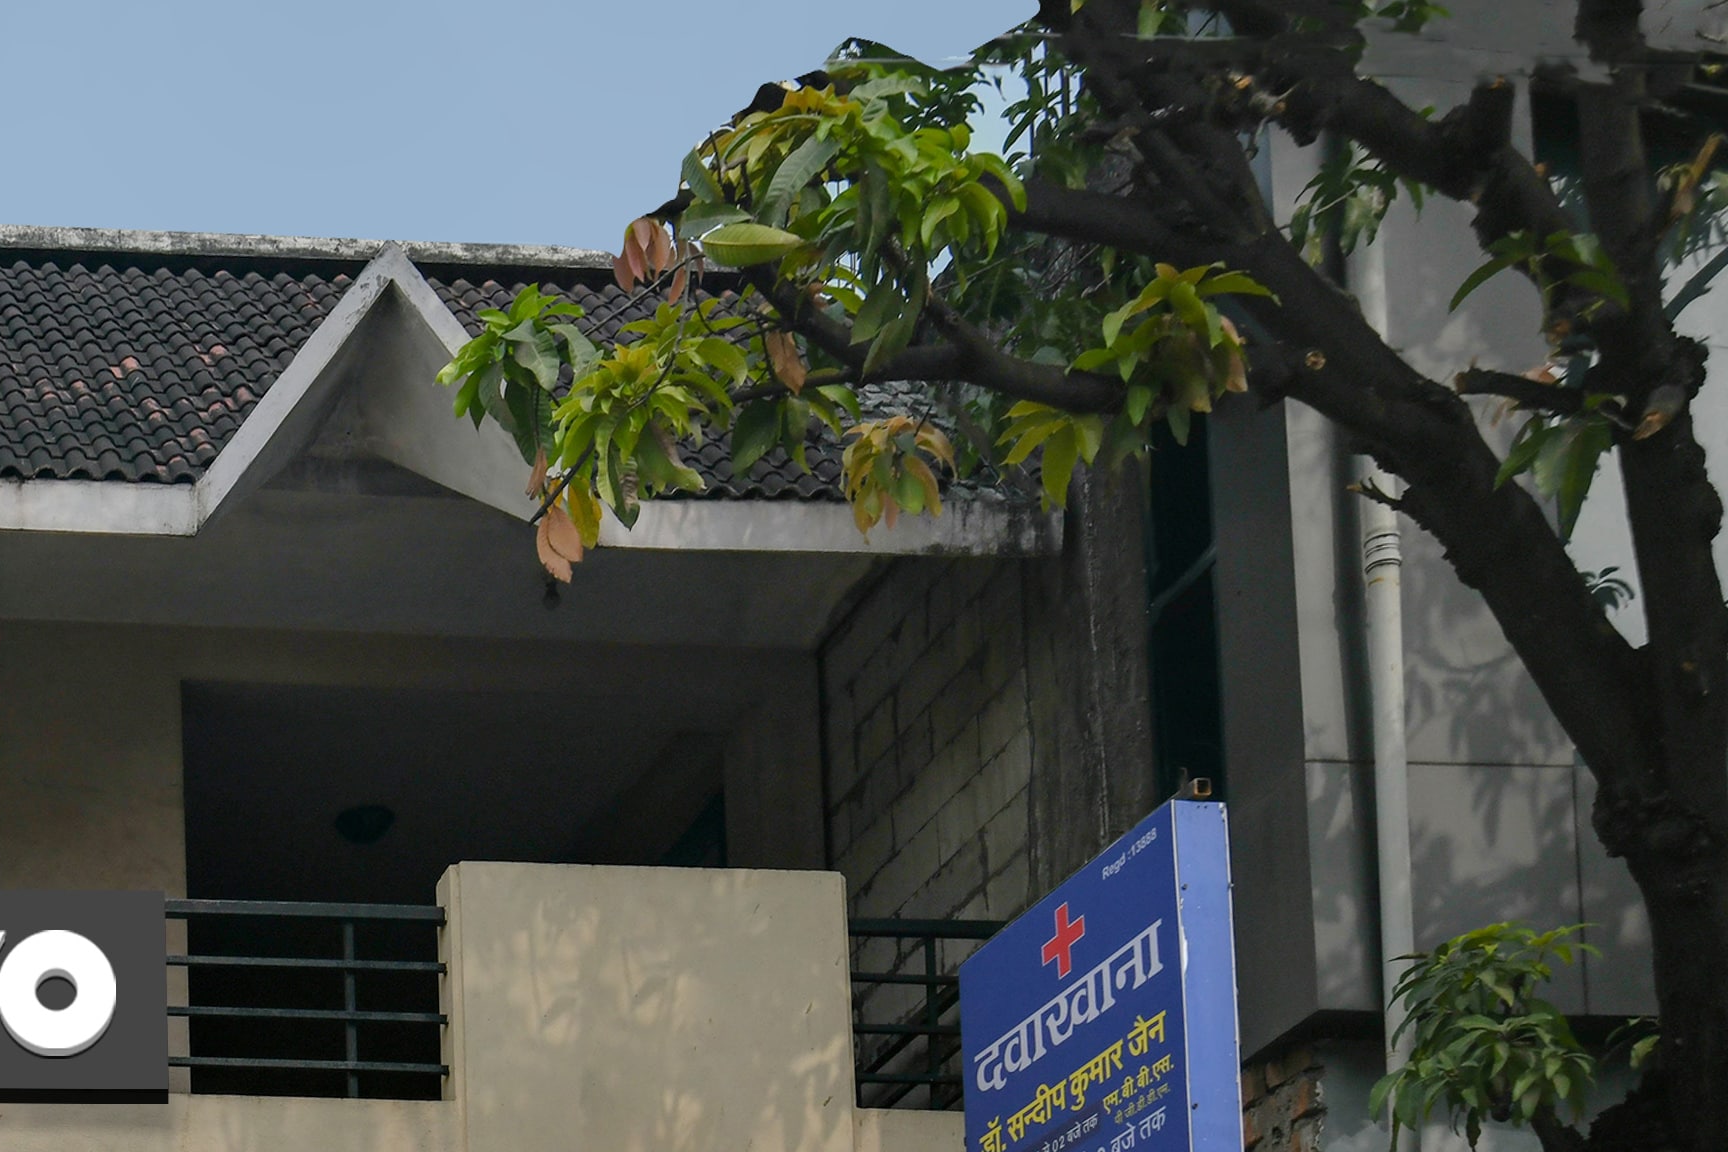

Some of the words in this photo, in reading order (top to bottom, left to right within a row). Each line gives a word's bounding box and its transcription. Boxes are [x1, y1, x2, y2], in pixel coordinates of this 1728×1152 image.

[1102, 852, 1126, 880] Regd
[974, 918, 1163, 1093] दवाखाना
[1006, 1083, 1067, 1142] सन्दीप
[1068, 1038, 1124, 1111] कुमार
[1127, 1010, 1167, 1057] जैन
[1066, 1121, 1081, 1142] बजे
[1082, 1113, 1099, 1131] तक
[1138, 1105, 1167, 1140] तक
